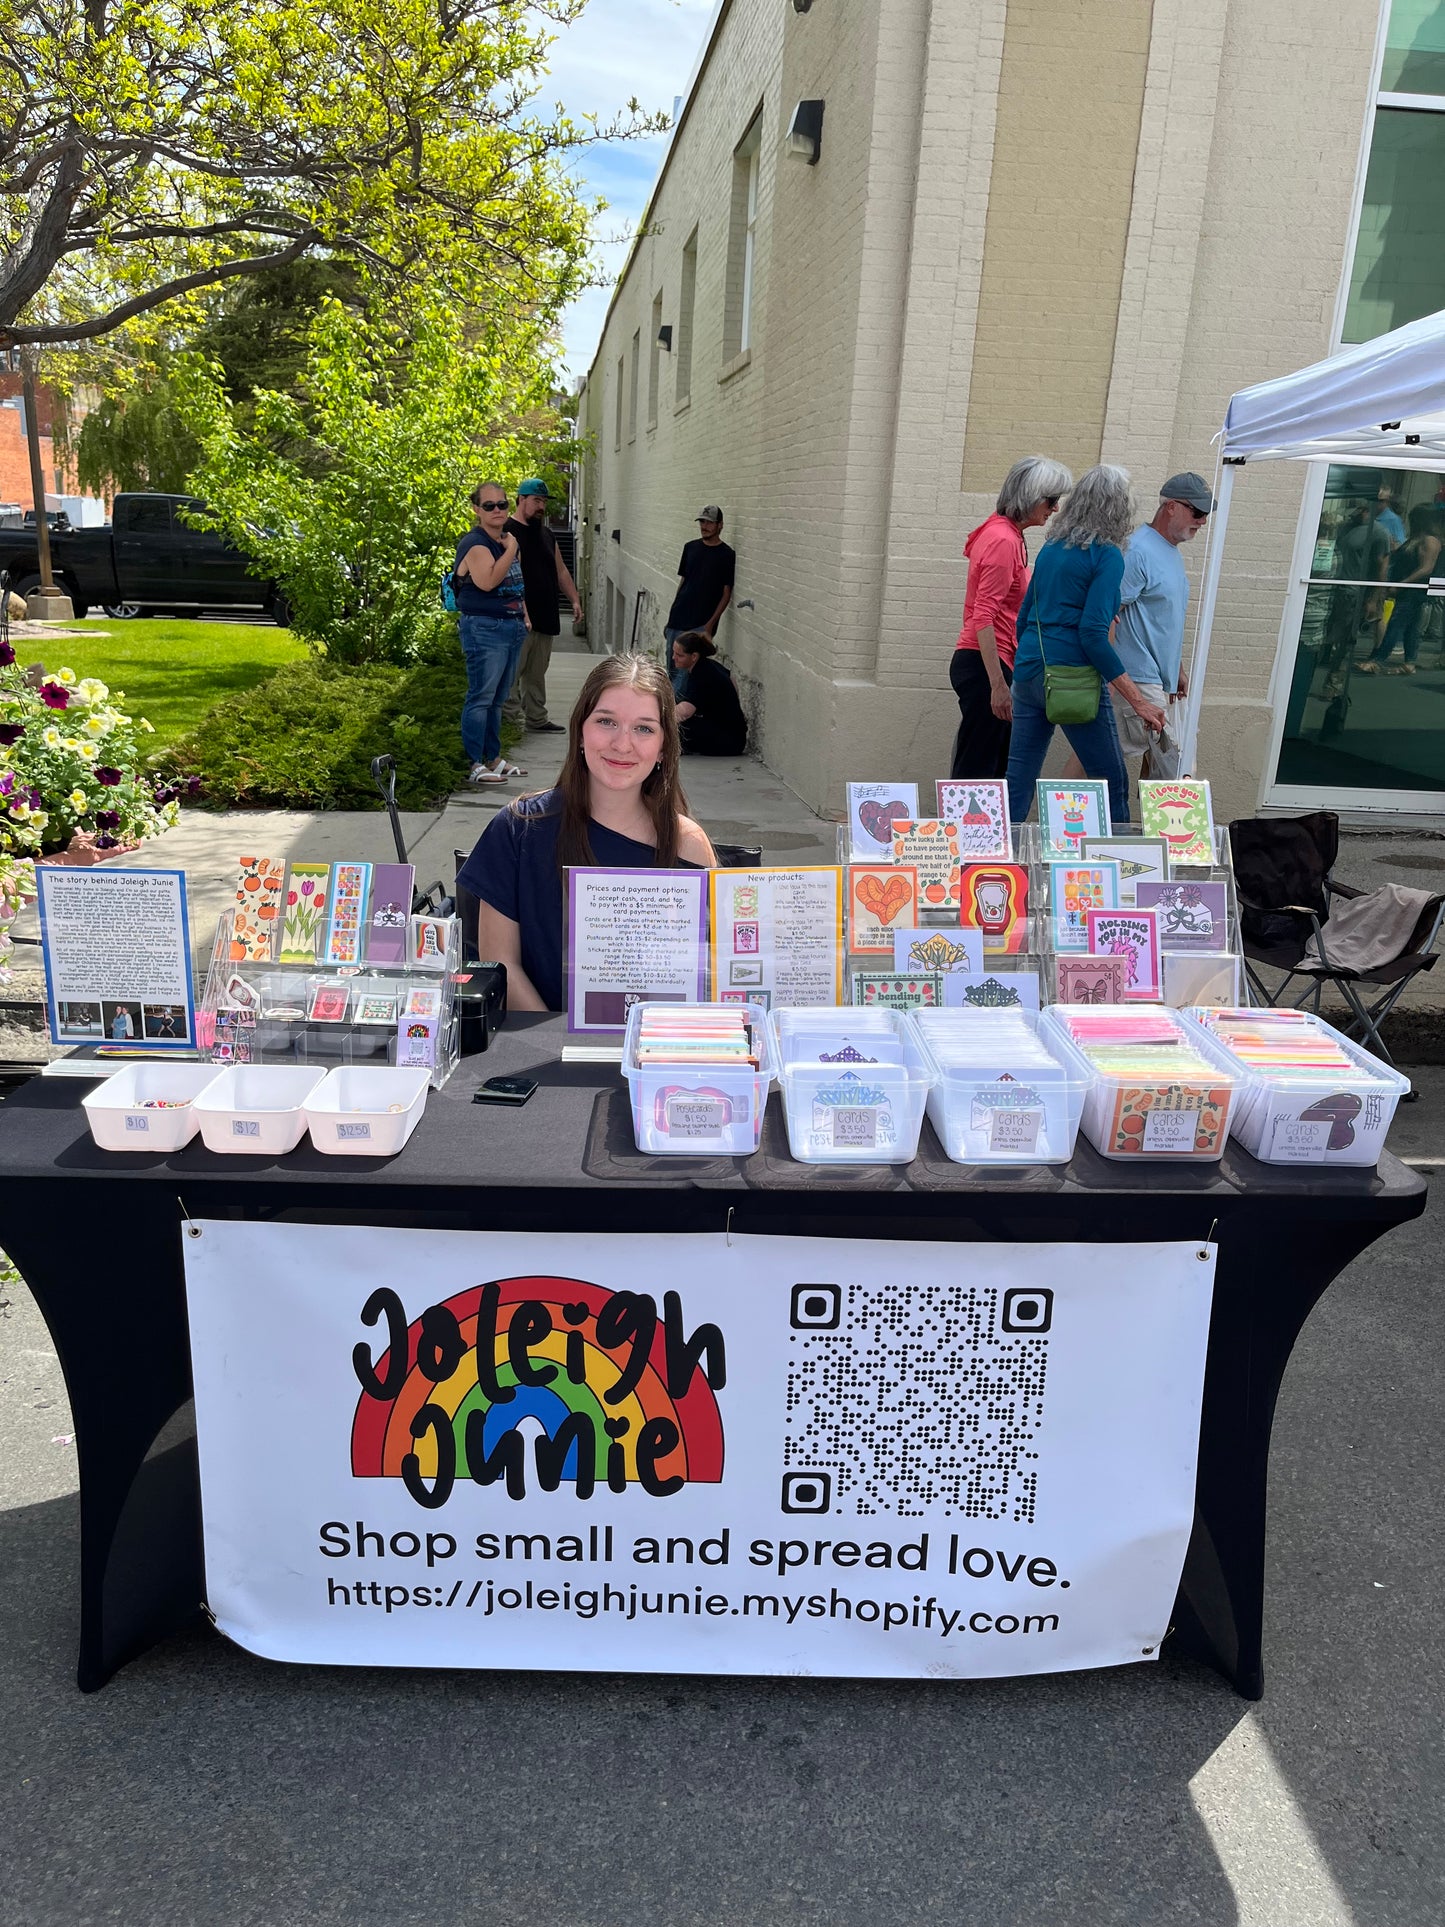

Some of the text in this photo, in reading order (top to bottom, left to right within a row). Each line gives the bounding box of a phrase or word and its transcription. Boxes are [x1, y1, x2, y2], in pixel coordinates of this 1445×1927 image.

[1155, 785, 1179, 798] love
[1179, 787, 1200, 800] you
[49, 876, 64, 884] The
[67, 877, 87, 885] story
[91, 877, 118, 885] behind
[120, 877, 149, 888] Joleigh
[768, 873, 805, 883] products:
[628, 886, 660, 895] payment
[662, 886, 690, 895] options:
[1098, 920, 1149, 933] HOLDING
[1098, 928, 1117, 946] YOU
[1119, 928, 1130, 936] IN
[1132, 933, 1149, 946] MY
[878, 992, 921, 1003] bending
[891, 1001, 908, 1010] not
[676, 1104, 713, 1113] Postcards
[127, 1117, 147, 1130] $10
[236, 1121, 258, 1135] $12
[353, 1282, 726, 1405] Joleigh
[402, 1406, 685, 1508] Junie
[318, 1521, 1071, 1589] Shop small and spread love.
[327, 1577, 1060, 1638] https://joleighjunie.myshopify.com
